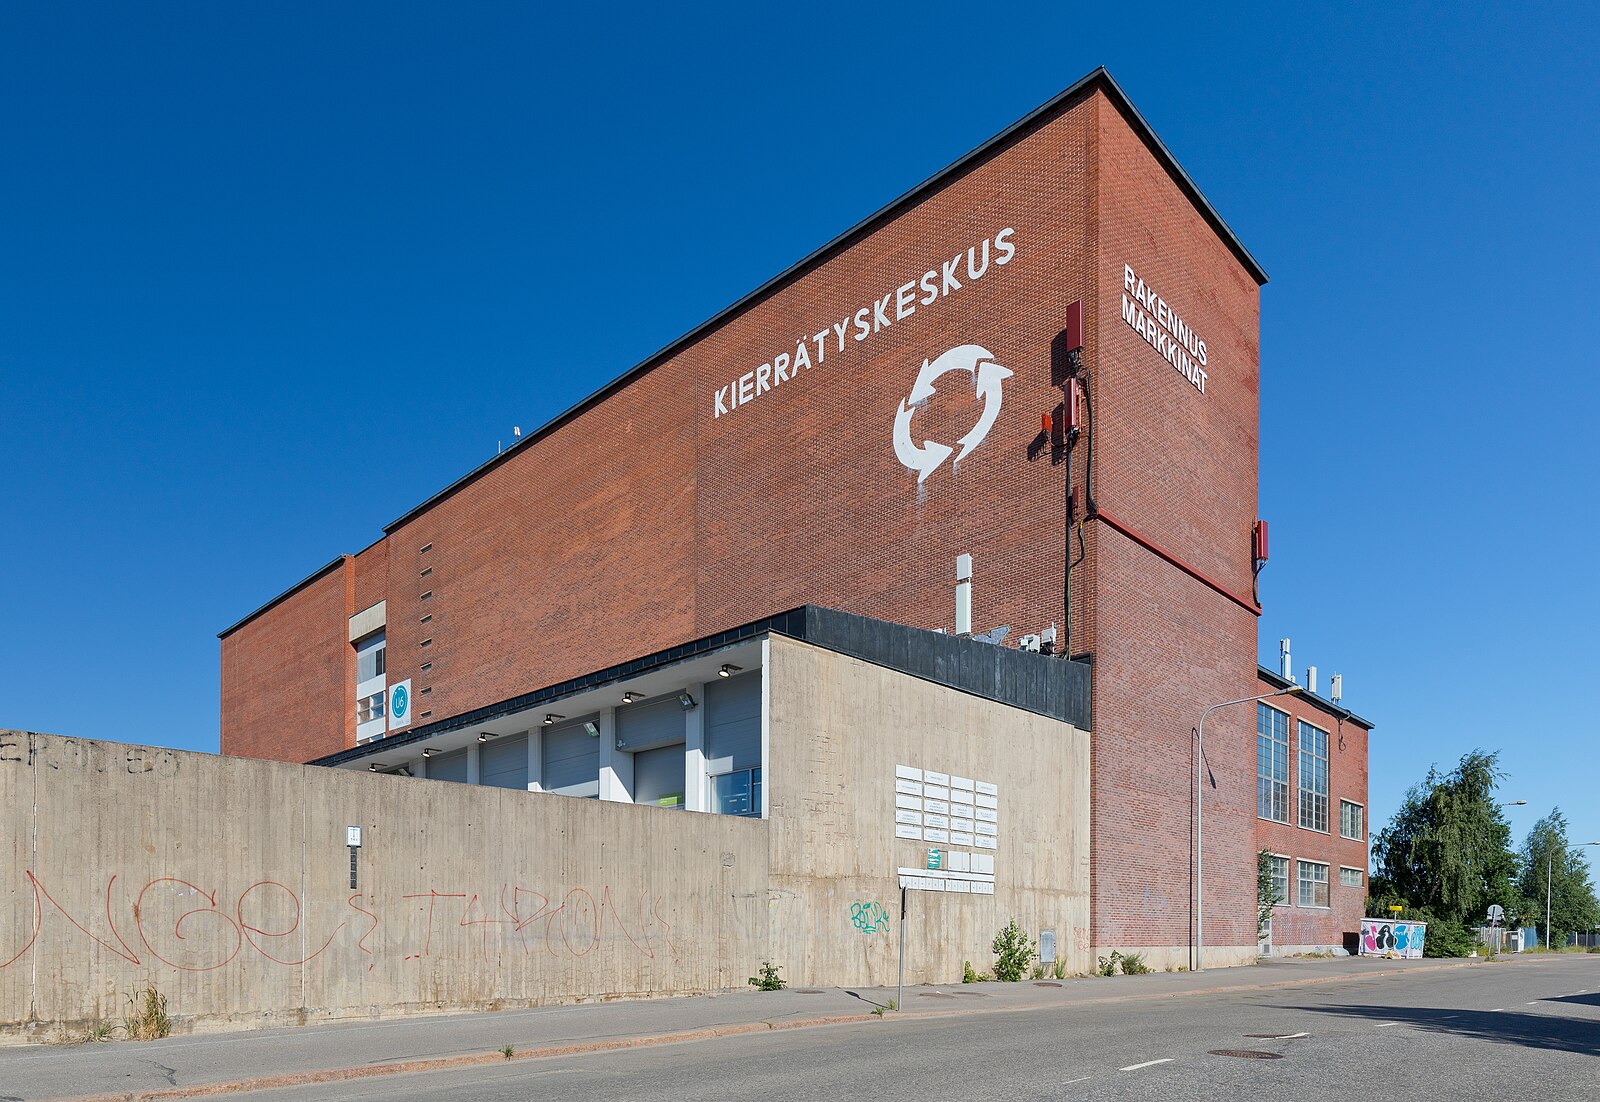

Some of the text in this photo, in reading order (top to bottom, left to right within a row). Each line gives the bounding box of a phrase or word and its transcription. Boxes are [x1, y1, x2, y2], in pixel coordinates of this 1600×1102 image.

[714, 227, 1015, 418] KIERRÄTYSKESKUS
[1122, 293, 1208, 395] MARKKINAT
[1124, 263, 1207, 366] RAKENNUS
